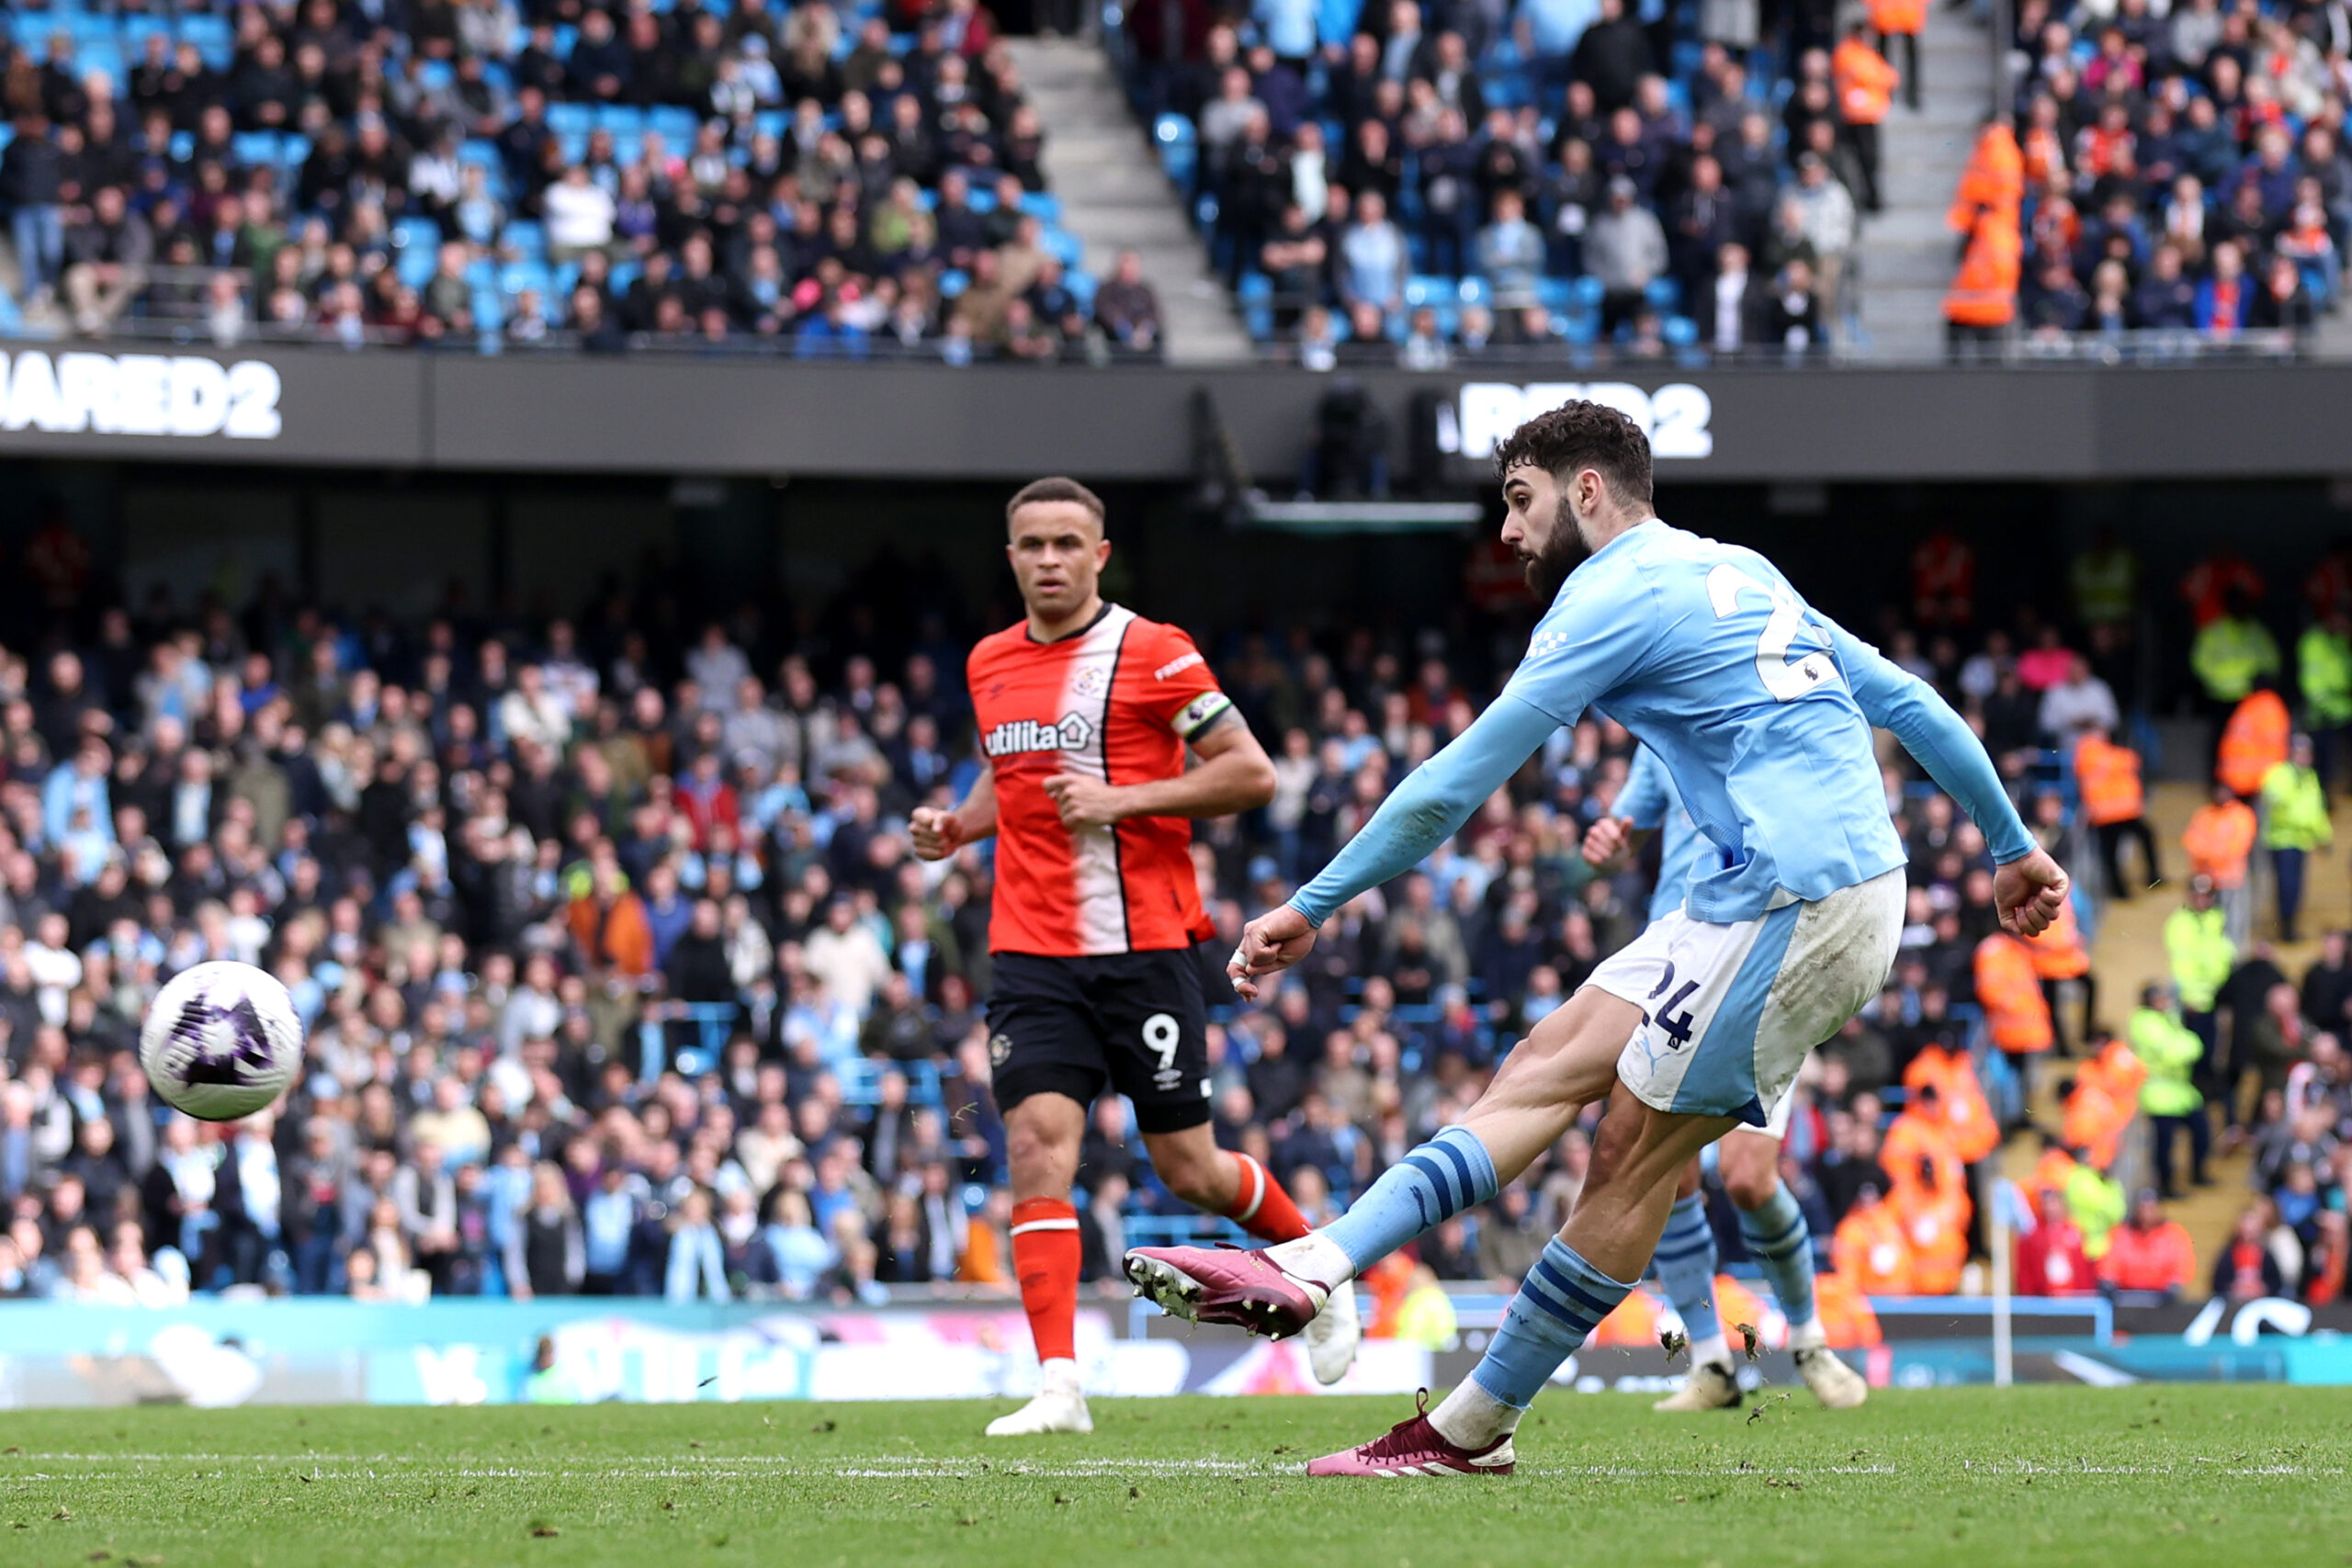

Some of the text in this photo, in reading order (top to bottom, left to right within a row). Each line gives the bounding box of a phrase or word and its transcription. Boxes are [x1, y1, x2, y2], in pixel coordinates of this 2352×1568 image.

[0, 350, 281, 438] ARED2
[985, 719, 1058, 757] utilita
[1142, 1013, 1180, 1070] 9
